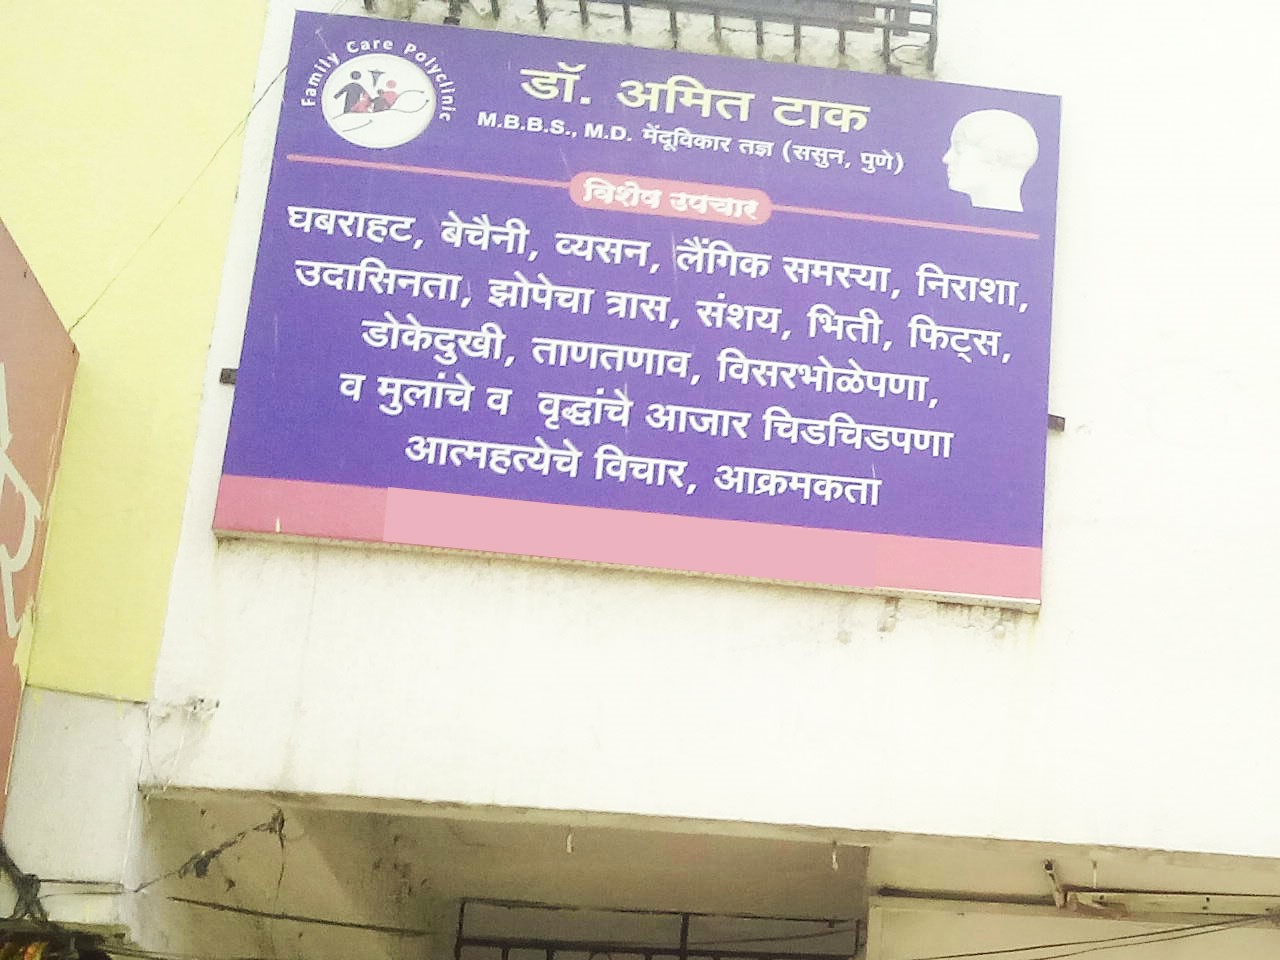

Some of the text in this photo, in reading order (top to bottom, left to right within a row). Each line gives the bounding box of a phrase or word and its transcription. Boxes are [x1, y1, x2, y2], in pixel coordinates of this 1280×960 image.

[301, 38, 458, 122] Family Care Polyclinic
[520, 61, 871, 133] डॉ. अमित टाक
[477, 110, 577, 138] M.B.B.S.,
[583, 122, 632, 142] M.D.
[641, 122, 734, 155] मेंदूविकार
[739, 139, 774, 158] तज्ञ
[860, 149, 905, 175] पुणे)
[583, 177, 759, 220] विशेष उपचार
[288, 205, 1030, 313] घबराहट, बेचैनी, व्यसन, लैंगिक समस्या, निराशा,
[295, 257, 1012, 363] उदासिनता, झोपेचा त्रास, संशय, भिती, फिट्स,
[361, 311, 939, 408] डोकेदुखी, ताणतणाव, विसरभोळेपणा,
[340, 371, 954, 458] व मुलांचे व वृद्धांचे आजार चिडचिडपणा
[405, 434, 882, 506] आत्महत्येचे विचार, आक्रमकता
